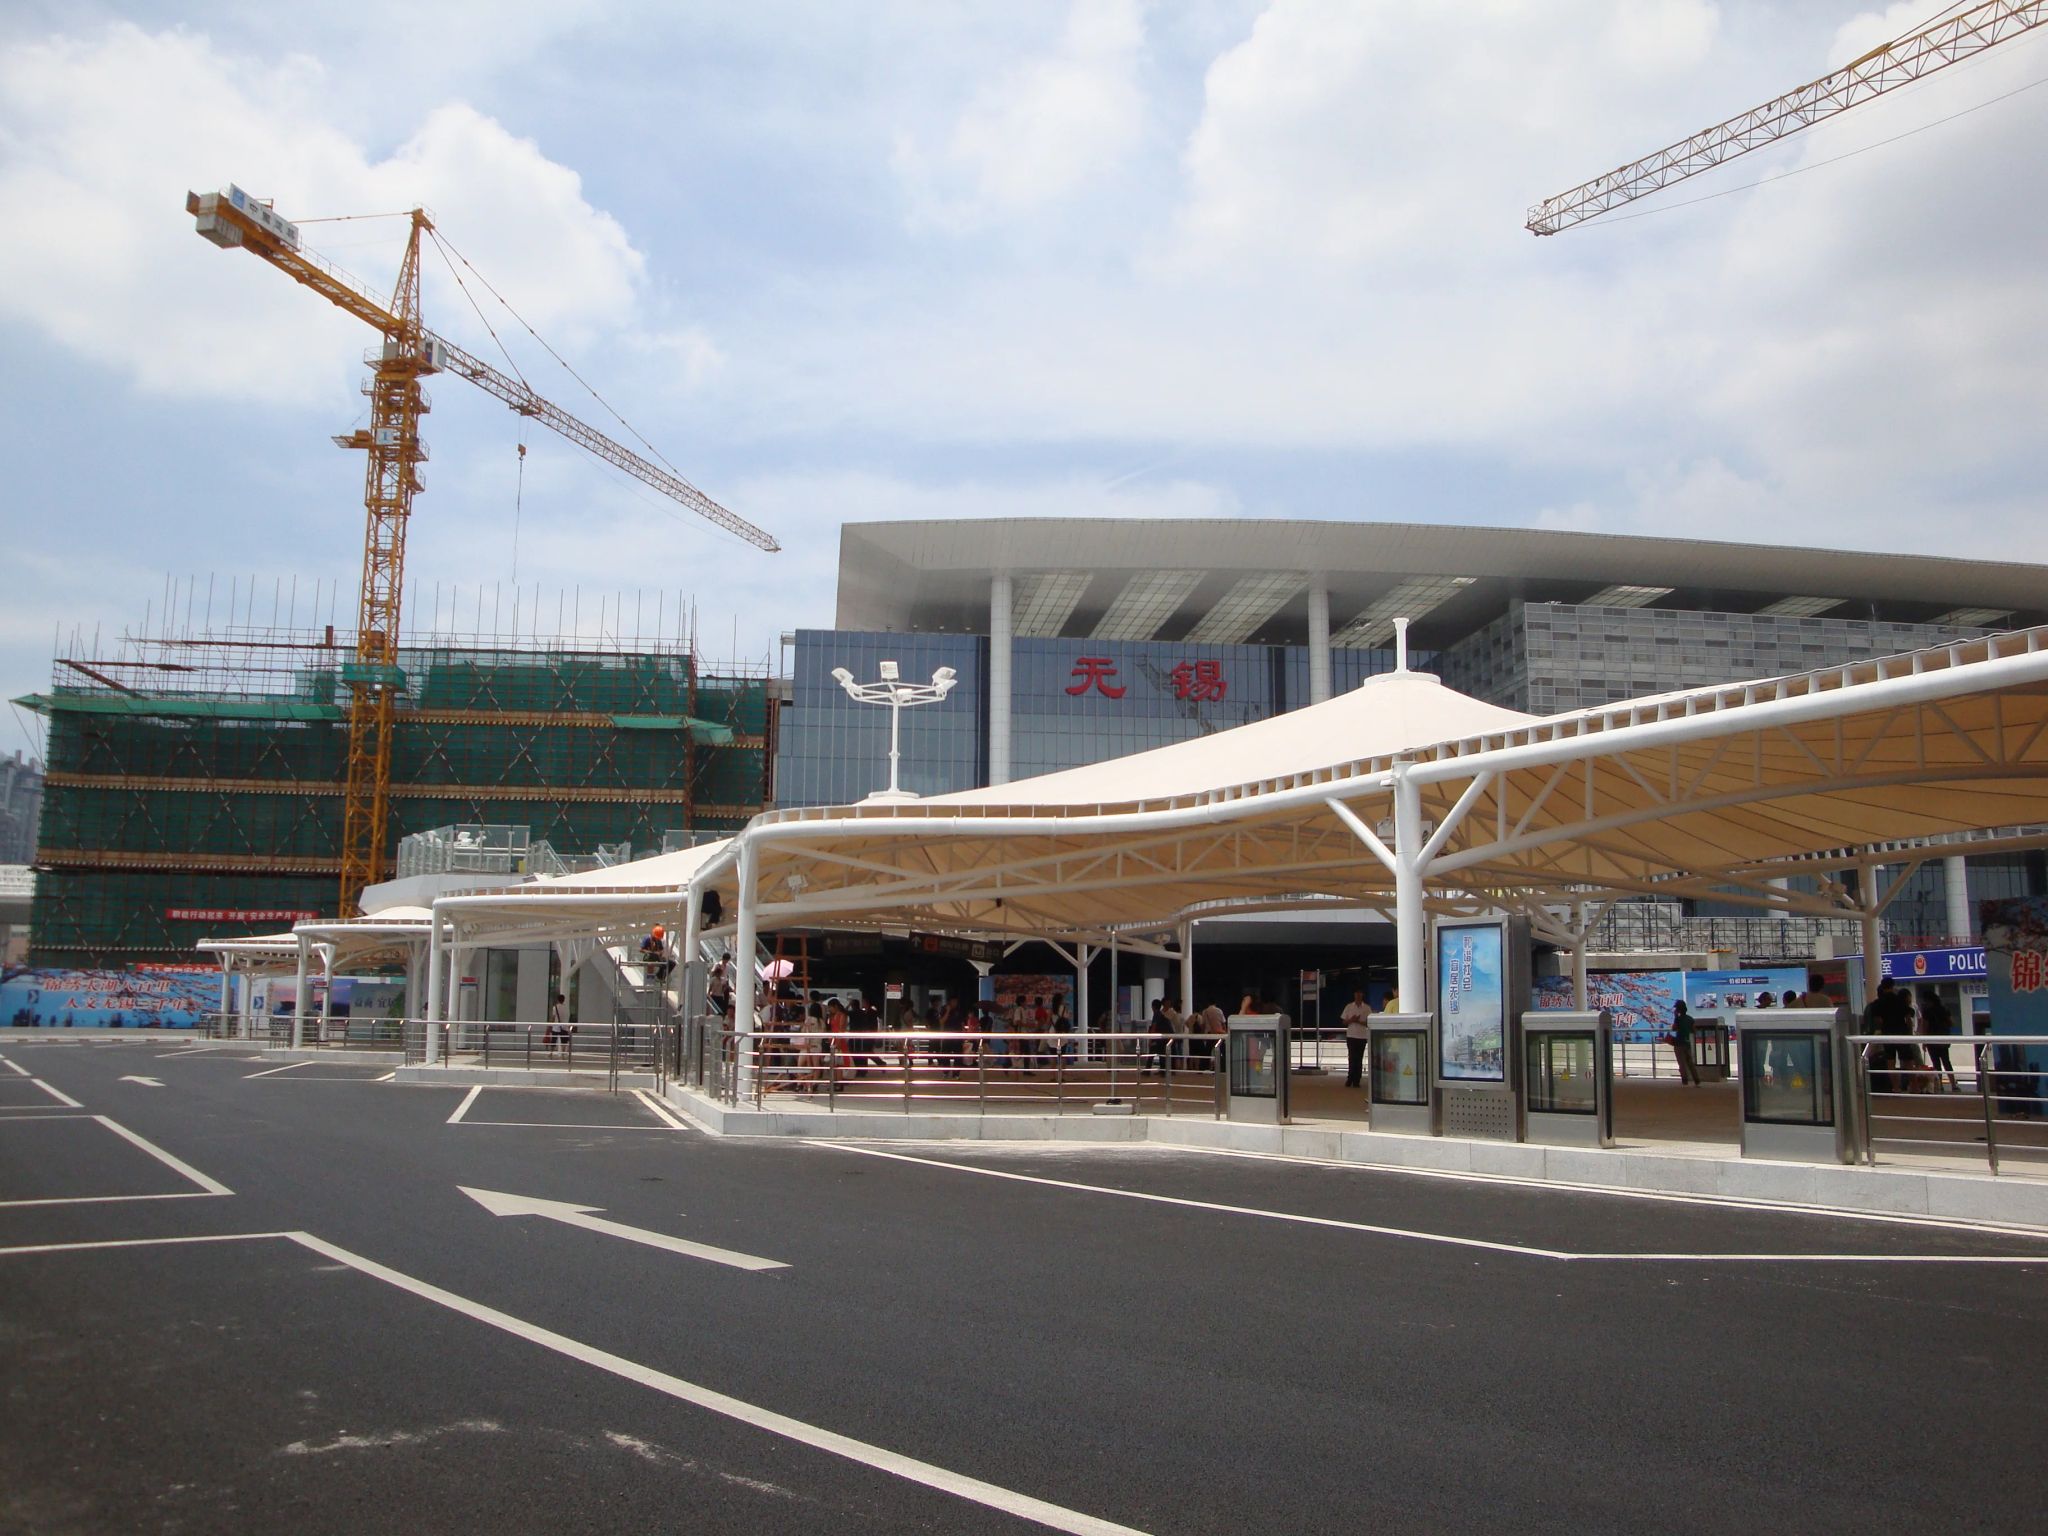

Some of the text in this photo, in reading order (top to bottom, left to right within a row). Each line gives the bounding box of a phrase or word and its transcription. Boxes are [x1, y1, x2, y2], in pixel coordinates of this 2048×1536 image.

[1065, 657, 1228, 702] 无锡
[2011, 951, 2048, 993] 锦
[1539, 992, 1624, 1009] 锦绣太八百里
